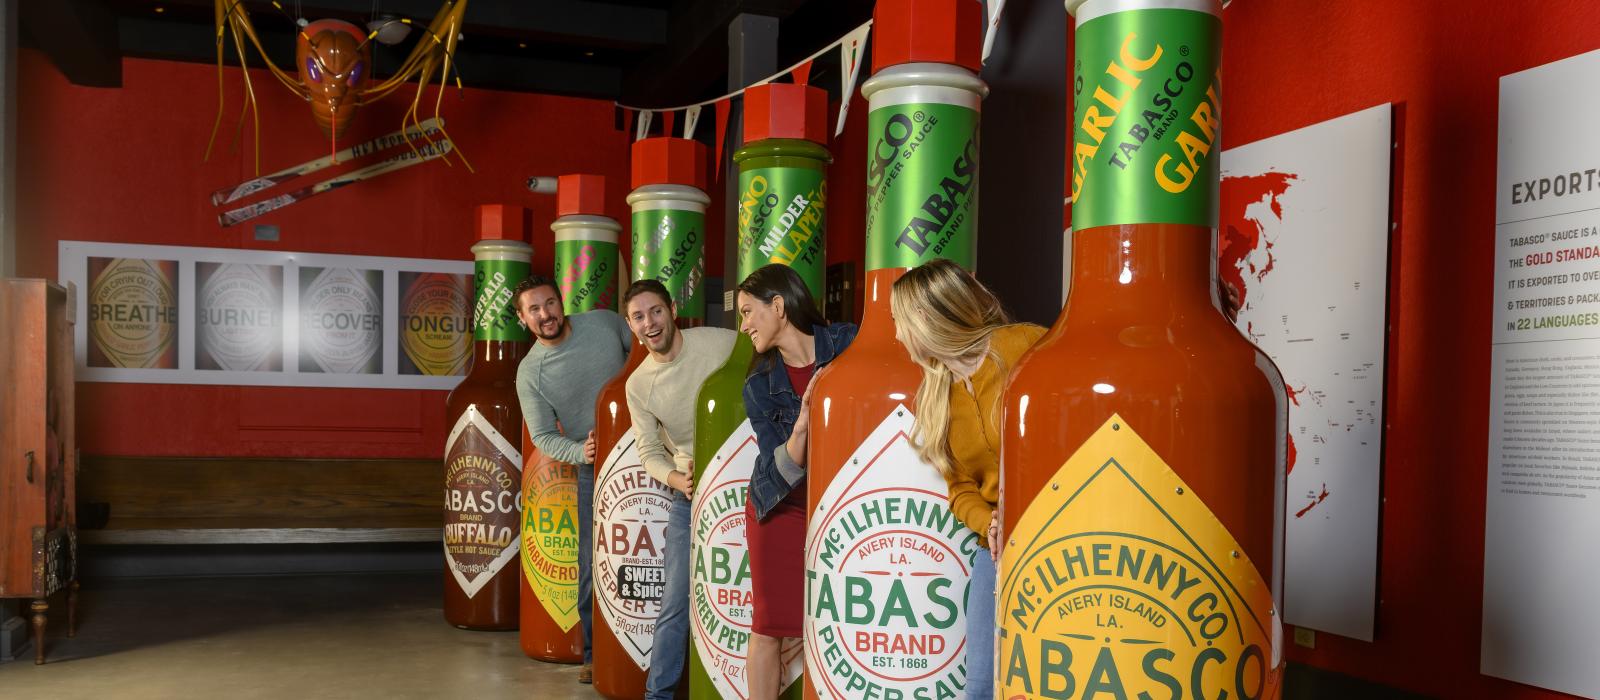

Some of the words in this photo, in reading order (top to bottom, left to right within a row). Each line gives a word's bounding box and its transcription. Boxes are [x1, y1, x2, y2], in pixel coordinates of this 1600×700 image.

[1153, 109, 1178, 140] BRAND
[903, 115, 938, 159] SAUCE
[1512, 168, 1600, 205] EXPORT
[758, 194, 809, 258] MILDER
[933, 213, 965, 255] BRAND
[1551, 229, 1579, 242] SAUCE
[1581, 227, 1589, 238] IS
[1591, 226, 1598, 236] A
[1509, 258, 1524, 269] THE
[1526, 252, 1553, 267] GOLD
[1556, 245, 1600, 263] STANDA
[1508, 280, 1515, 290] IT
[1517, 279, 1525, 288] IS
[1527, 274, 1568, 288] EXPORTED
[1570, 273, 1581, 282] TO
[1582, 270, 1600, 282] OVE
[90, 303, 176, 324] BREATHE
[480, 287, 514, 331] STYLE
[1507, 301, 1514, 311] &
[1516, 294, 1566, 310] TERRITORIES
[1568, 295, 1574, 305] &
[1576, 293, 1600, 304] PACK
[1507, 322, 1516, 331] IN
[1517, 318, 1531, 331] 22
[1533, 313, 1599, 330] LANGUAGES
[620, 497, 643, 512] AVERY
[445, 523, 512, 548] BUFFALO
[544, 535, 579, 549] BRAN
[479, 547, 501, 556] SAUCE
[526, 536, 578, 580] HABANERO
[858, 537, 895, 560] AVERY
[900, 537, 945, 563] ISLAND
[890, 553, 912, 565] LA.
[624, 567, 666, 582] SWEET
[622, 583, 631, 597] &
[633, 582, 665, 599] Spic
[718, 588, 753, 607] BRA
[807, 569, 971, 630] TABAS
[694, 582, 720, 636] GREEN
[729, 607, 746, 618] EST.
[1057, 593, 1103, 620] AVERY
[1109, 593, 1167, 628] ISLAND
[1096, 613, 1124, 629] LA.
[855, 631, 946, 656] BRAND
[713, 655, 722, 668] 5
[728, 665, 740, 678] oz
[872, 656, 896, 668] EST.
[900, 658, 928, 669] 1868
[1001, 628, 1266, 700] ABASCO
